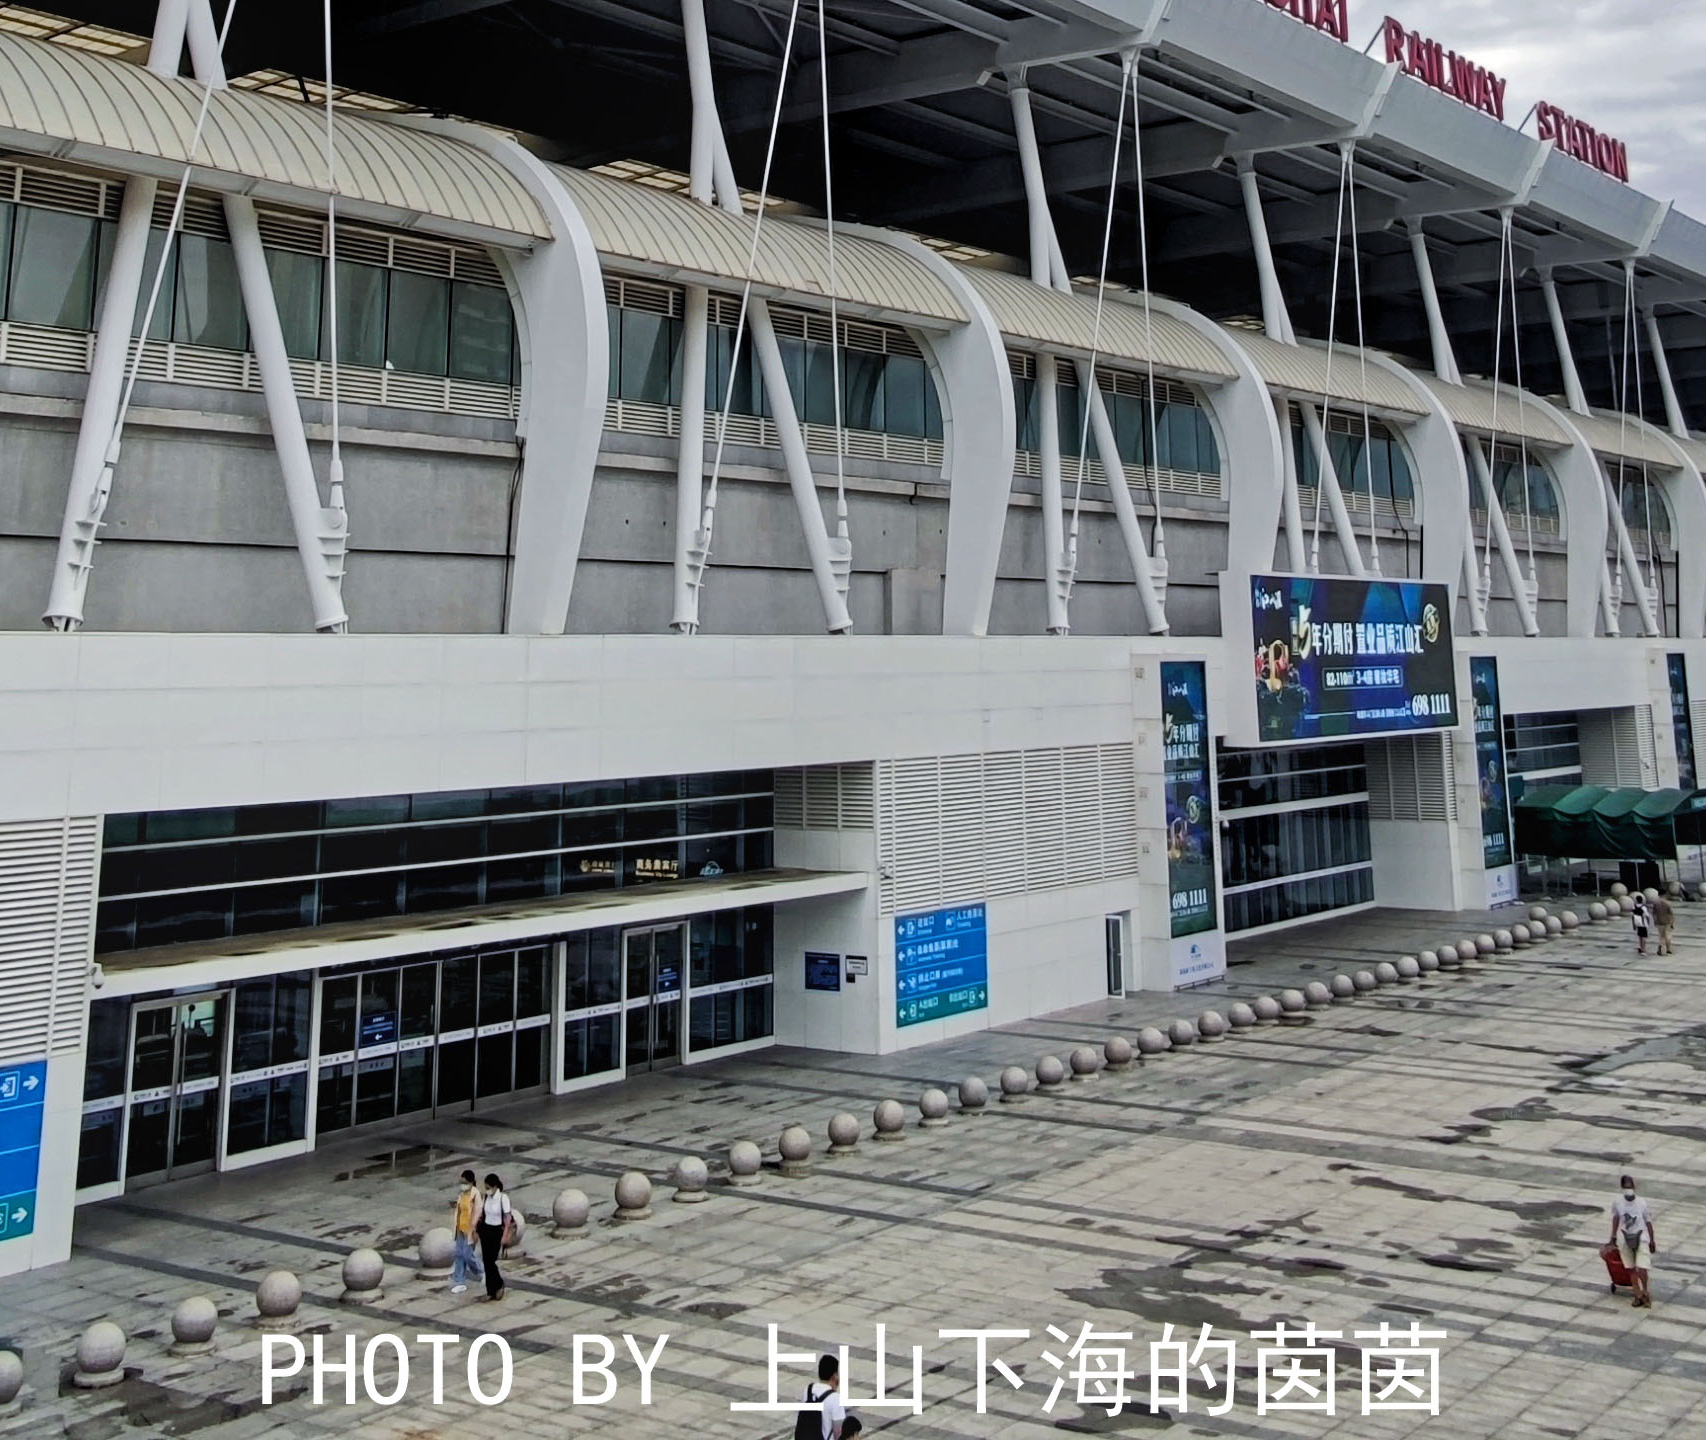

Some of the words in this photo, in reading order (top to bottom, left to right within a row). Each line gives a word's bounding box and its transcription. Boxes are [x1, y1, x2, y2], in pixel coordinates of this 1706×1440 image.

[1384, 15, 1506, 122] RAILWAY
[1537, 101, 1629, 183] STATION
[1412, 695, 1428, 716] 698
[1431, 693, 1451, 714] 1111
[1190, 888, 1207, 906] 1111
